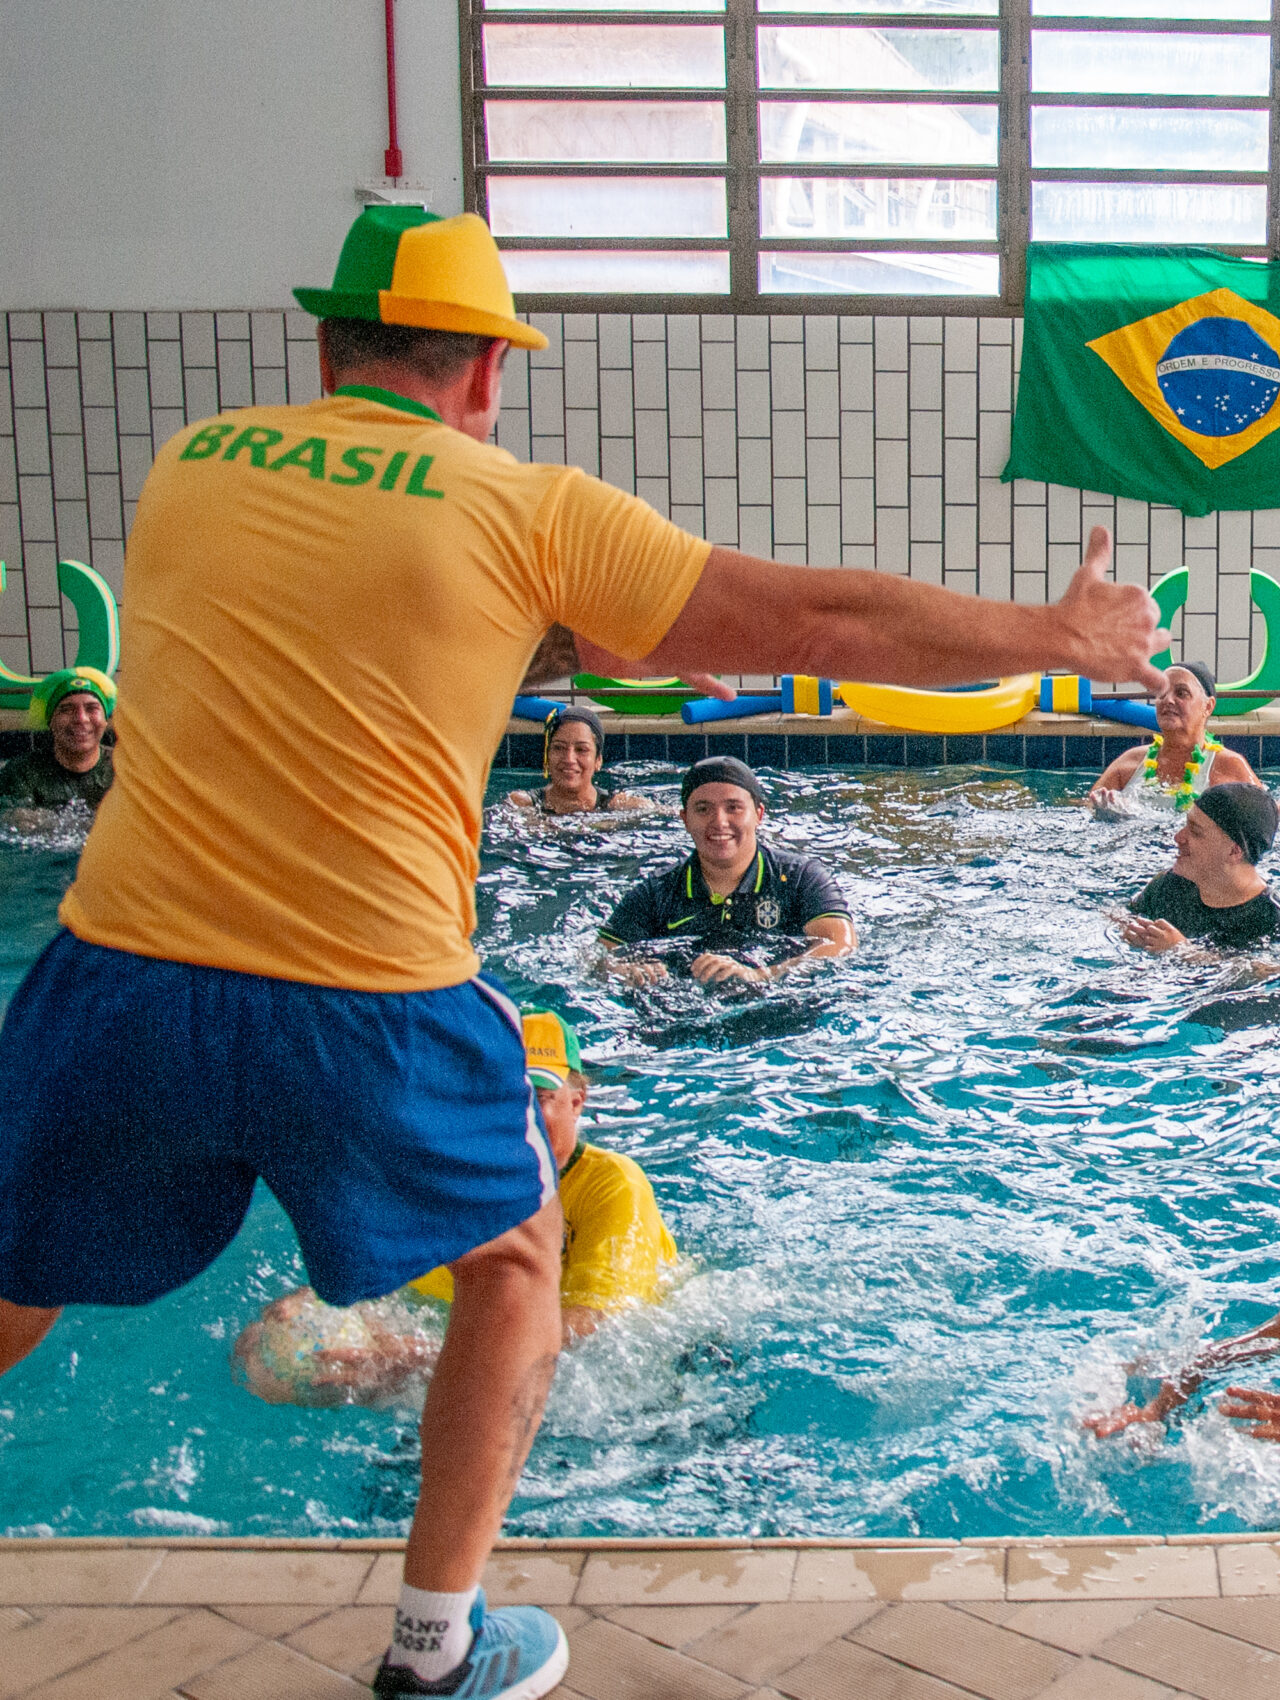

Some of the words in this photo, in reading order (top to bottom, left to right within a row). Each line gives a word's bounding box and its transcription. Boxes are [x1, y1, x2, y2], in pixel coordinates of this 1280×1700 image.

[1158, 358, 1196, 374] ORDEM
[1201, 357, 1210, 366] E
[1214, 358, 1280, 379] PROGRESSO
[179, 424, 445, 499] BRASIL
[526, 1046, 559, 1058] RASIL
